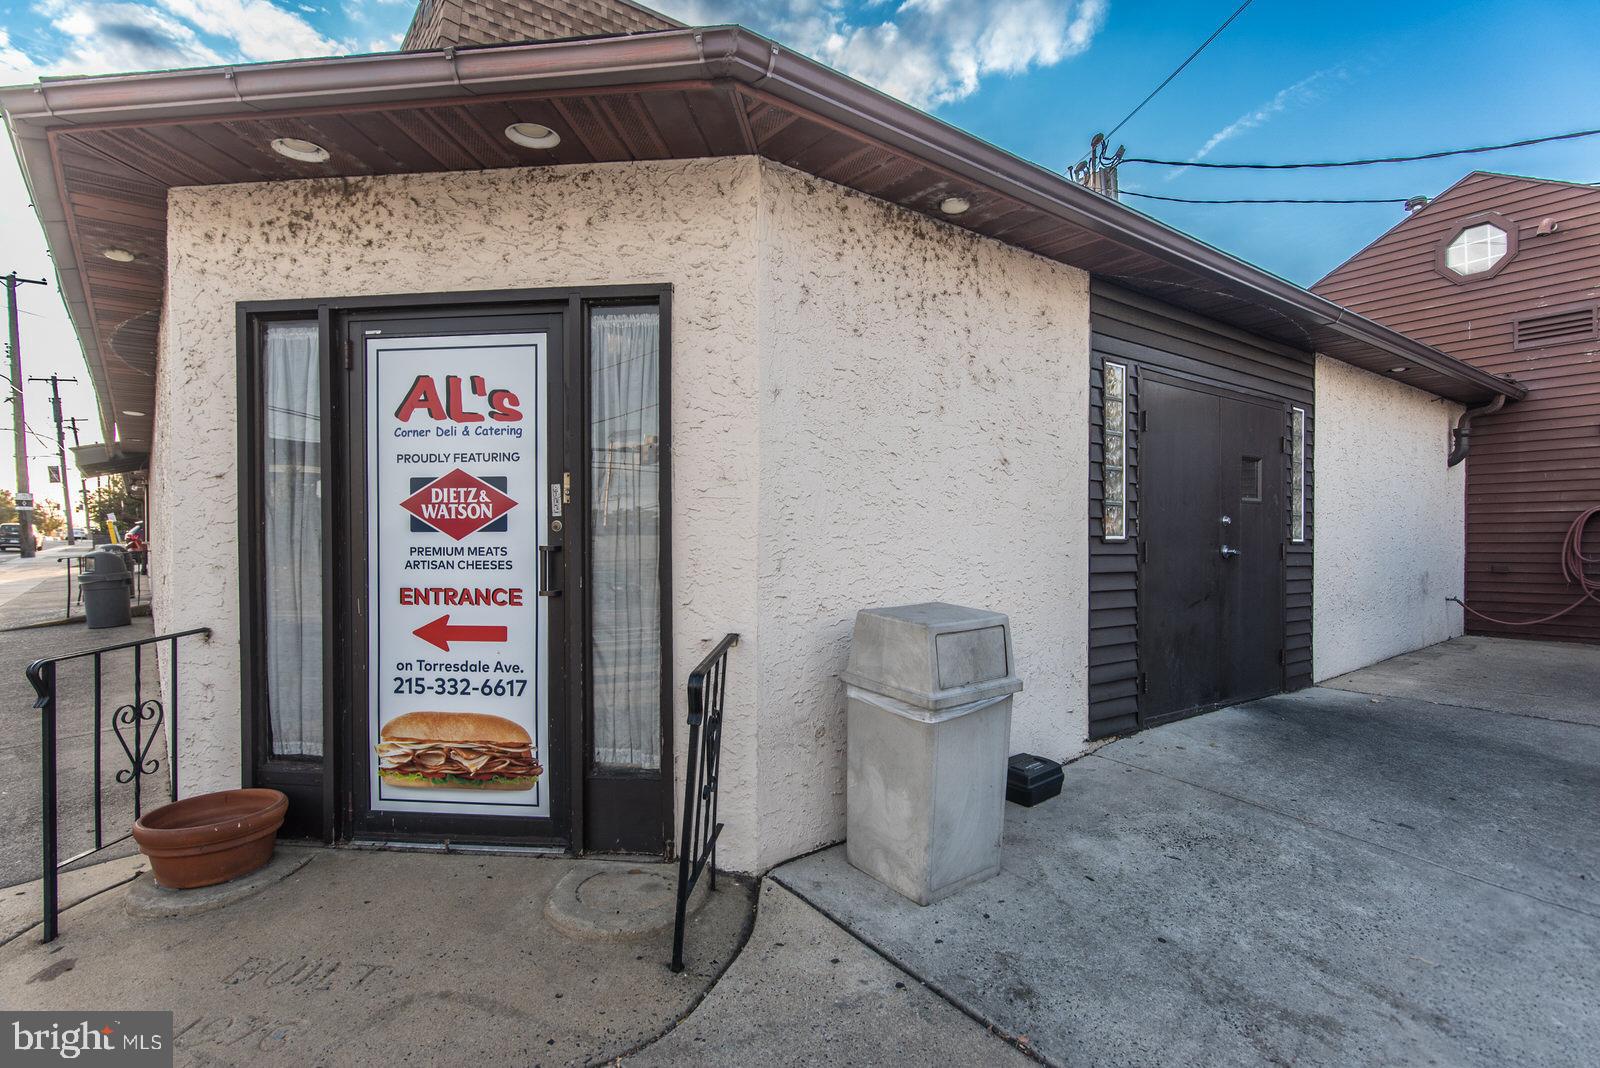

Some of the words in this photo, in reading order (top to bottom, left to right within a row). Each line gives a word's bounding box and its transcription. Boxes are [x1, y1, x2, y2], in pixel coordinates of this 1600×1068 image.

[394, 374, 524, 424] AL's
[394, 427, 431, 438] Corner
[436, 426, 457, 437] Deli
[462, 426, 470, 437] &
[474, 425, 523, 438] Catering
[396, 453, 451, 464] PROUDLY
[453, 452, 521, 463] FEATURING
[431, 487, 478, 503] DIETZ
[479, 490, 491, 503] &
[421, 503, 493, 519] WATSON
[409, 547, 465, 557] PREMIUM
[467, 546, 508, 556] MEATS
[404, 560, 455, 570] ARTISAN
[457, 560, 513, 570] CHEESES
[399, 587, 523, 607] ENTRANCE
[396, 662, 413, 672] on
[416, 660, 490, 673] Torresdale
[493, 660, 524, 674] Ave.
[393, 677, 528, 697] 215-332-6617
